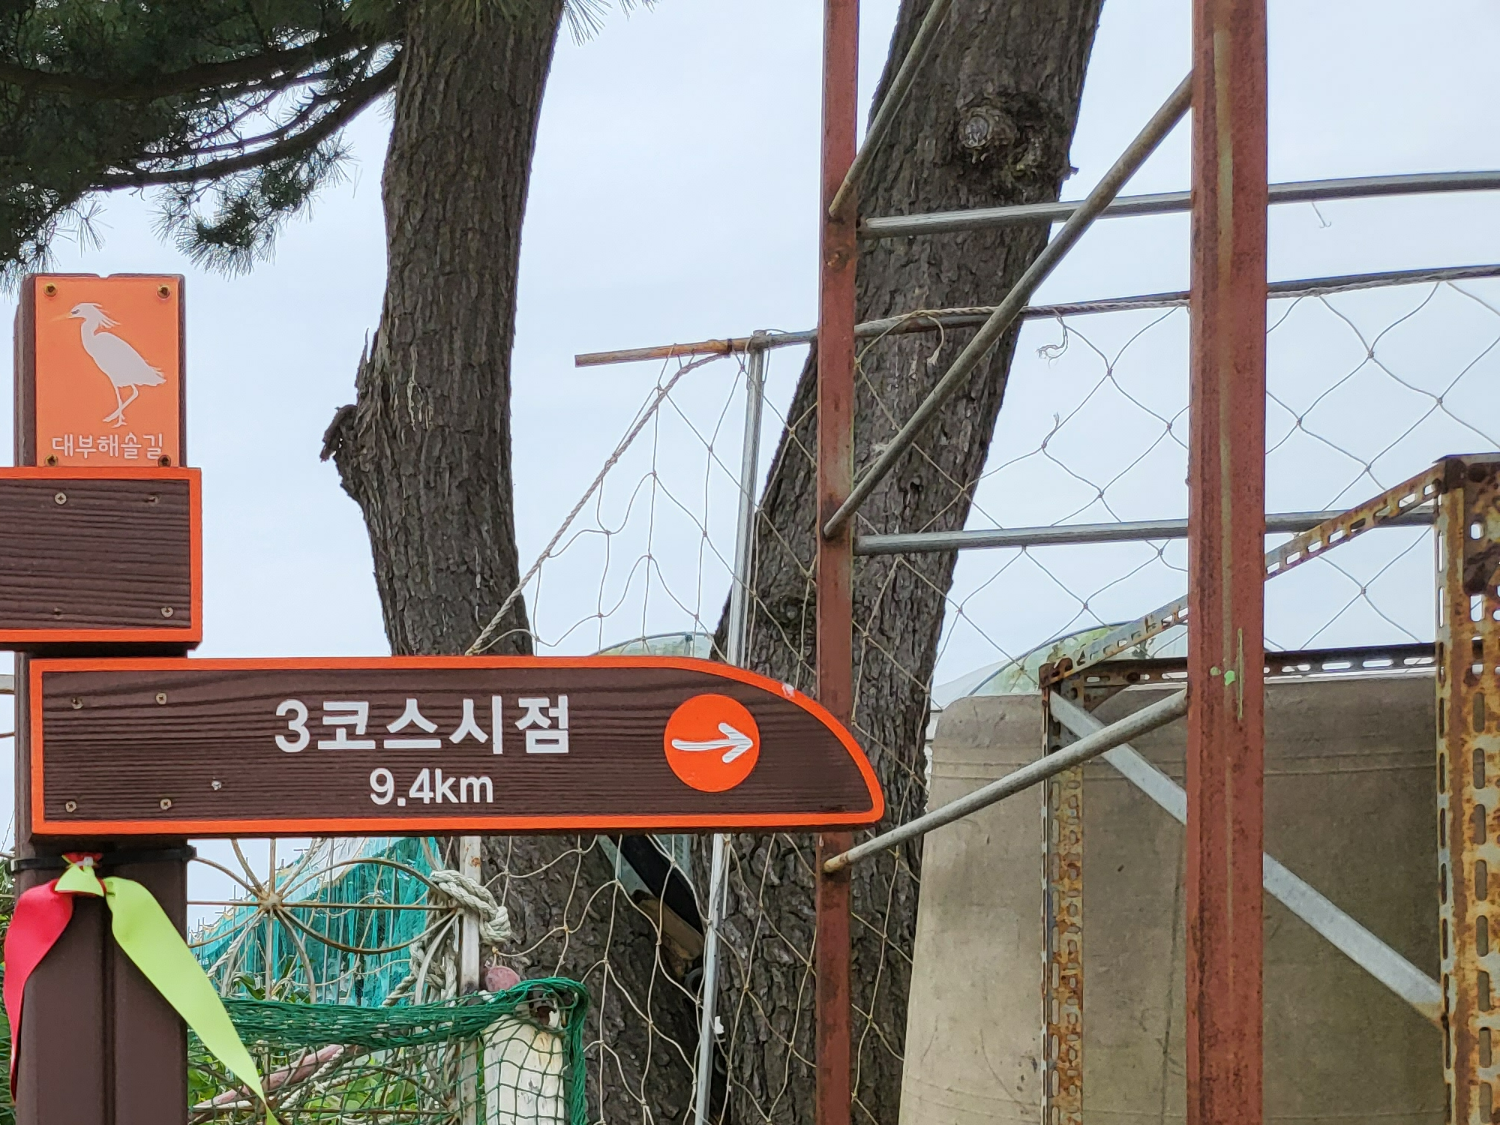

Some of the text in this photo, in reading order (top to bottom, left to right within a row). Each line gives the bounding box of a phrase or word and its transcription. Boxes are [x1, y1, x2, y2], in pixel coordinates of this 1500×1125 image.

[52, 432, 163, 460] 대부해솔길
[274, 695, 571, 755] 3코스시점
[369, 768, 495, 807] 9.4km
